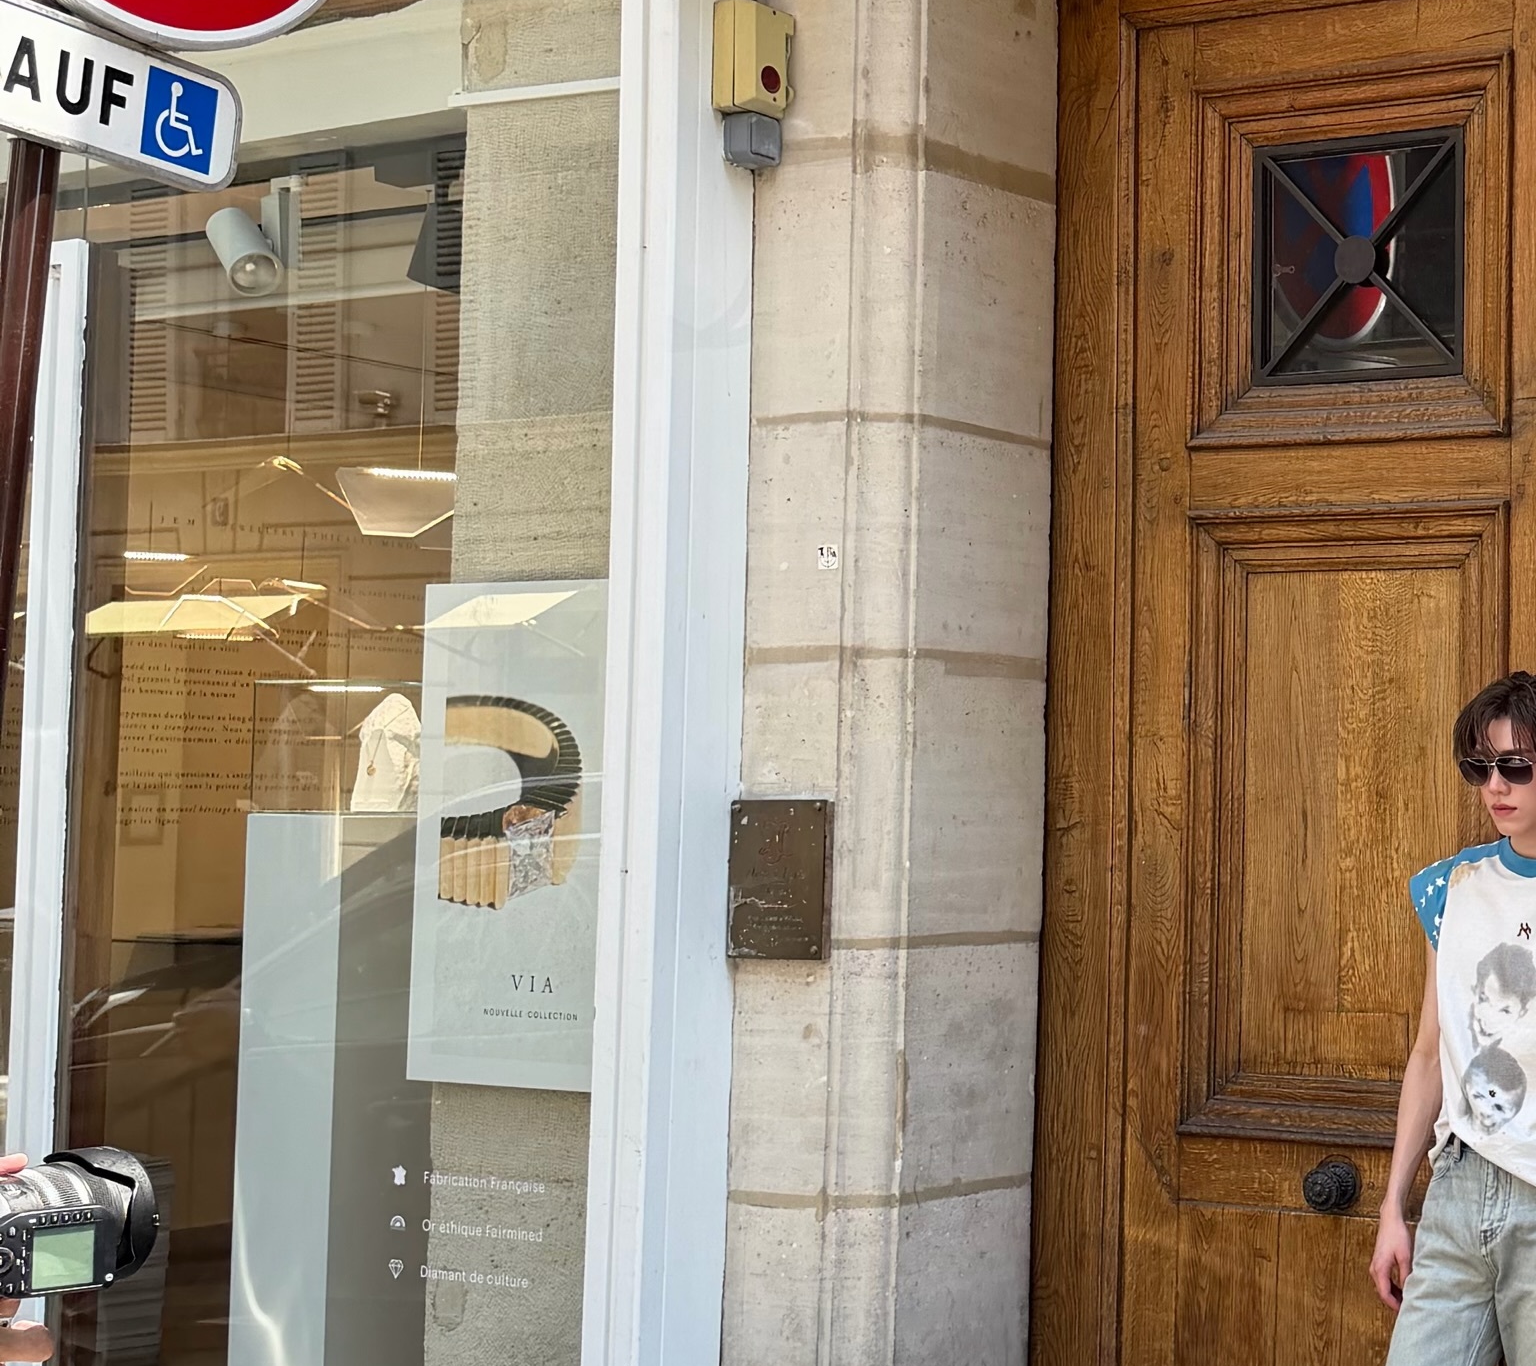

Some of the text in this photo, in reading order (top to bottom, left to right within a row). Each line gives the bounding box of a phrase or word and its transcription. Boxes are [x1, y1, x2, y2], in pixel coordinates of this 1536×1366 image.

[0, 35, 135, 126] AUF
[511, 974, 553, 993] VIA
[483, 1008, 578, 1021] NOUVELLE COLLECTION
[423, 1171, 546, 1194] Fabrication Française
[422, 1218, 543, 1242] Or éthique Fairmined
[420, 1265, 529, 1288] Diamant de culture
